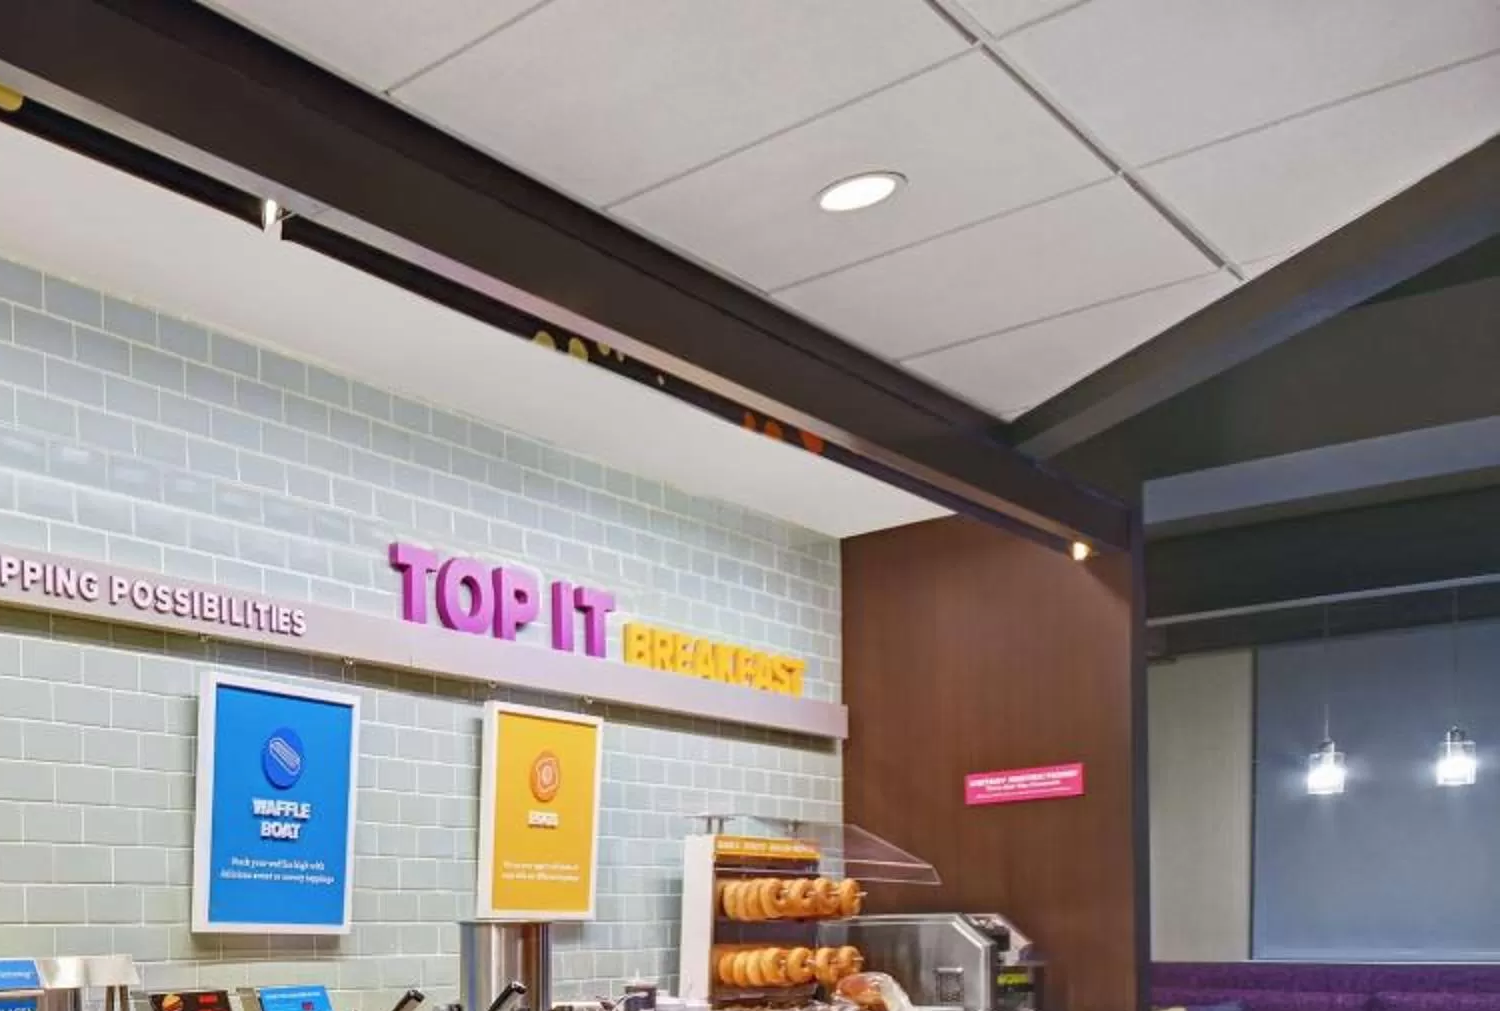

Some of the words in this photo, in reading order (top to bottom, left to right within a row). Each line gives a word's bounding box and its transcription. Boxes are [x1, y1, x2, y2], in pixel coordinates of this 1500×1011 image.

[109, 575, 307, 636] POSSIBILITIES
[389, 541, 540, 641] TOP
[551, 580, 616, 658] IT
[622, 622, 806, 698] BREAKFAST
[251, 797, 312, 819] WAFFLE
[260, 821, 301, 840] BOAT
